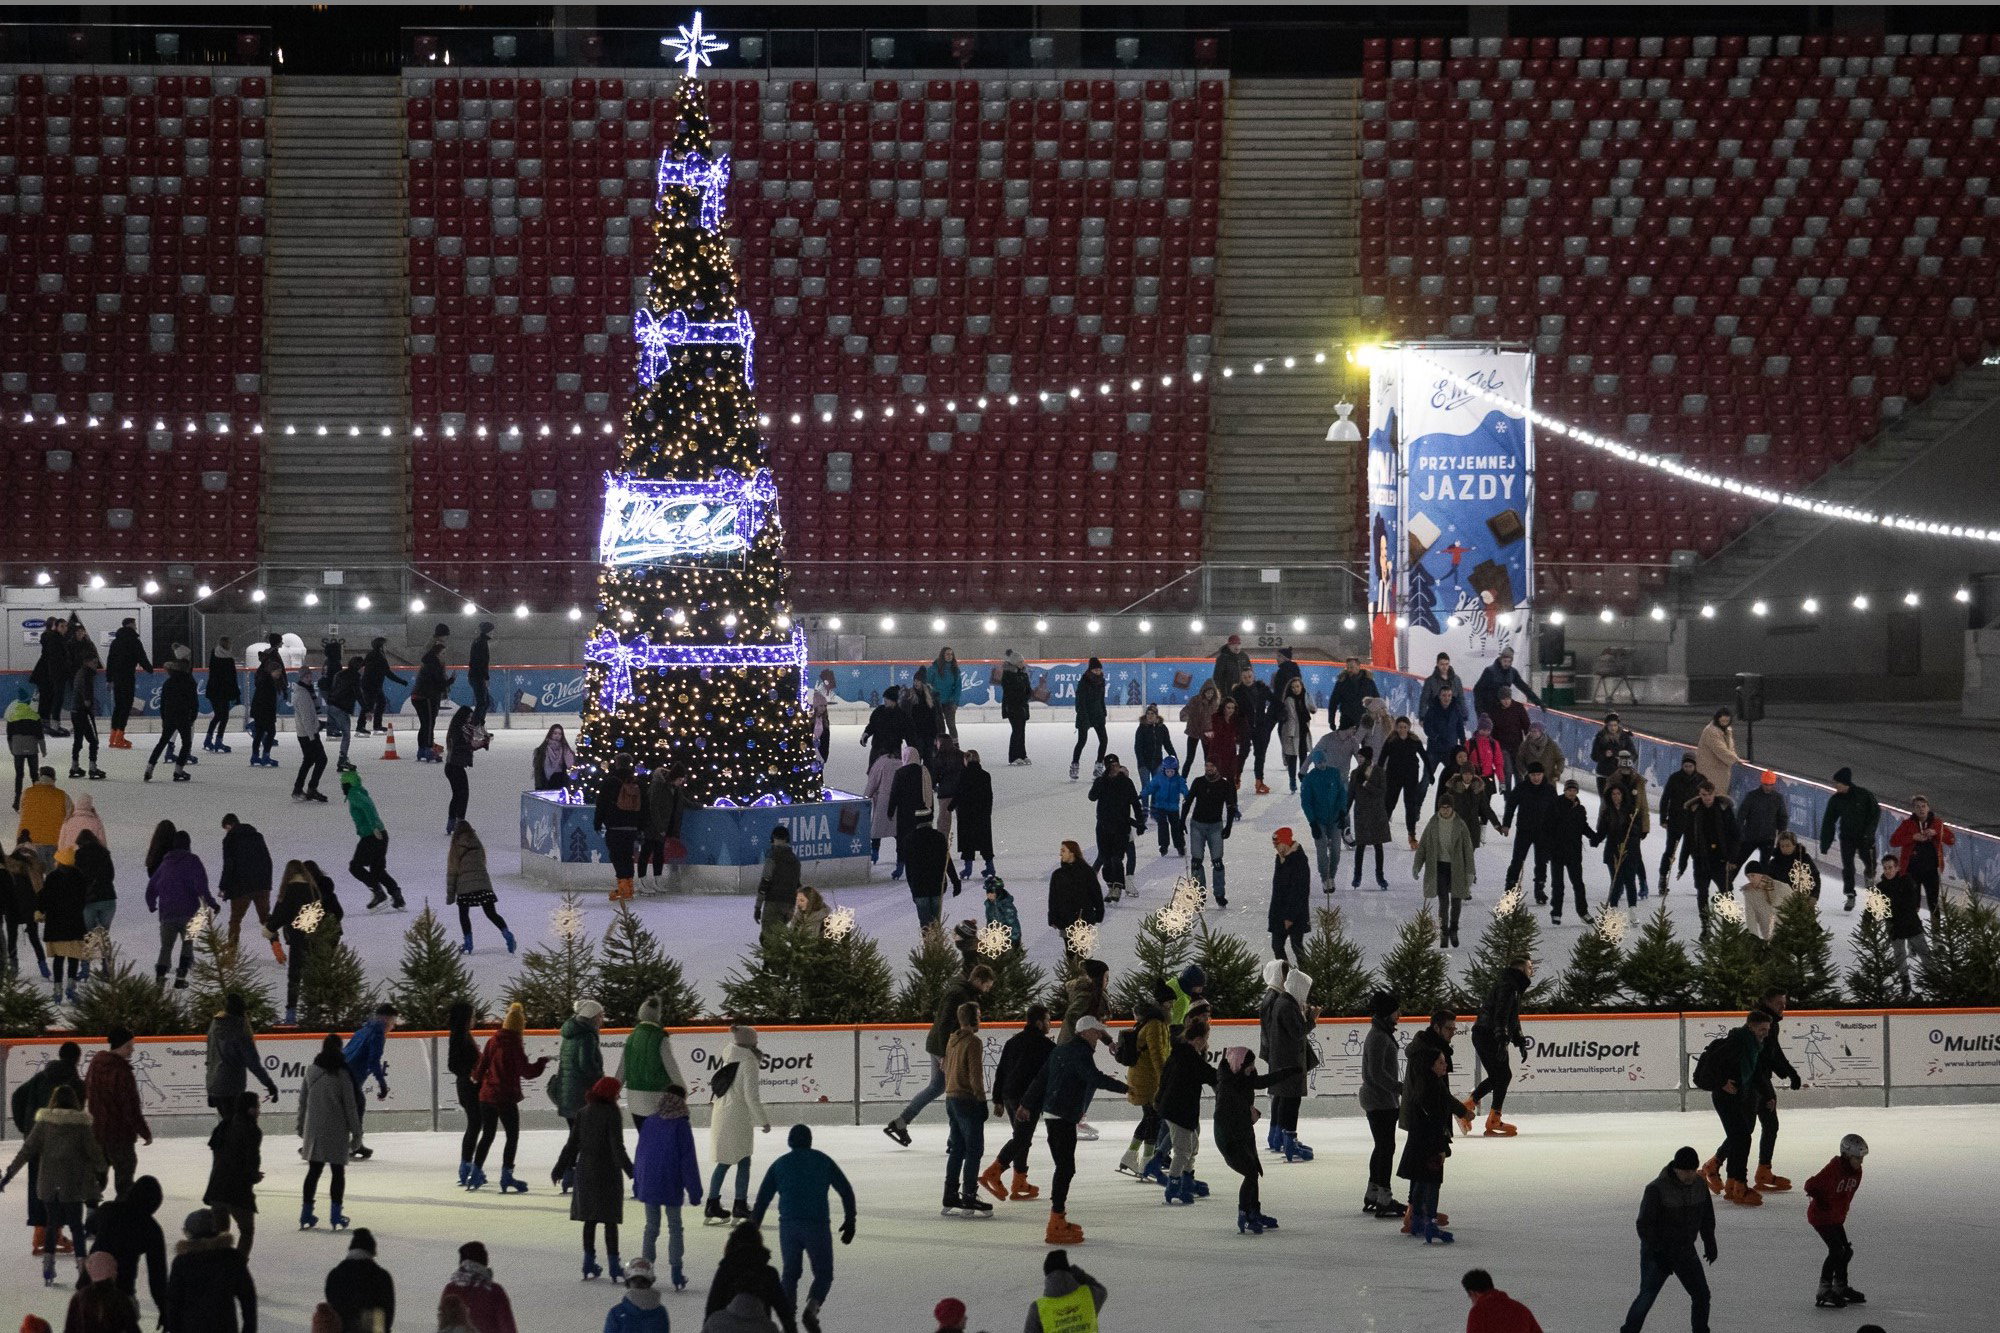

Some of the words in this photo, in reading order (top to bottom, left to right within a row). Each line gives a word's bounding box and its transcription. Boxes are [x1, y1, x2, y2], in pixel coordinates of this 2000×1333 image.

[1431, 369, 1504, 411] E.Wdel
[1419, 455, 1516, 470] PRZYJEMNEJ
[1419, 474, 1515, 500] JAZDY
[1258, 637, 1282, 646] S23
[1055, 673, 1110, 681] PRZYJJ
[541, 675, 585, 707] E.Wed
[1054, 683, 1111, 698] JAY
[1536, 1040, 1641, 1060] MultiSport
[706, 1053, 814, 1073] MSport
[1536, 1065, 1626, 1075] www.kartamultisport.pl
